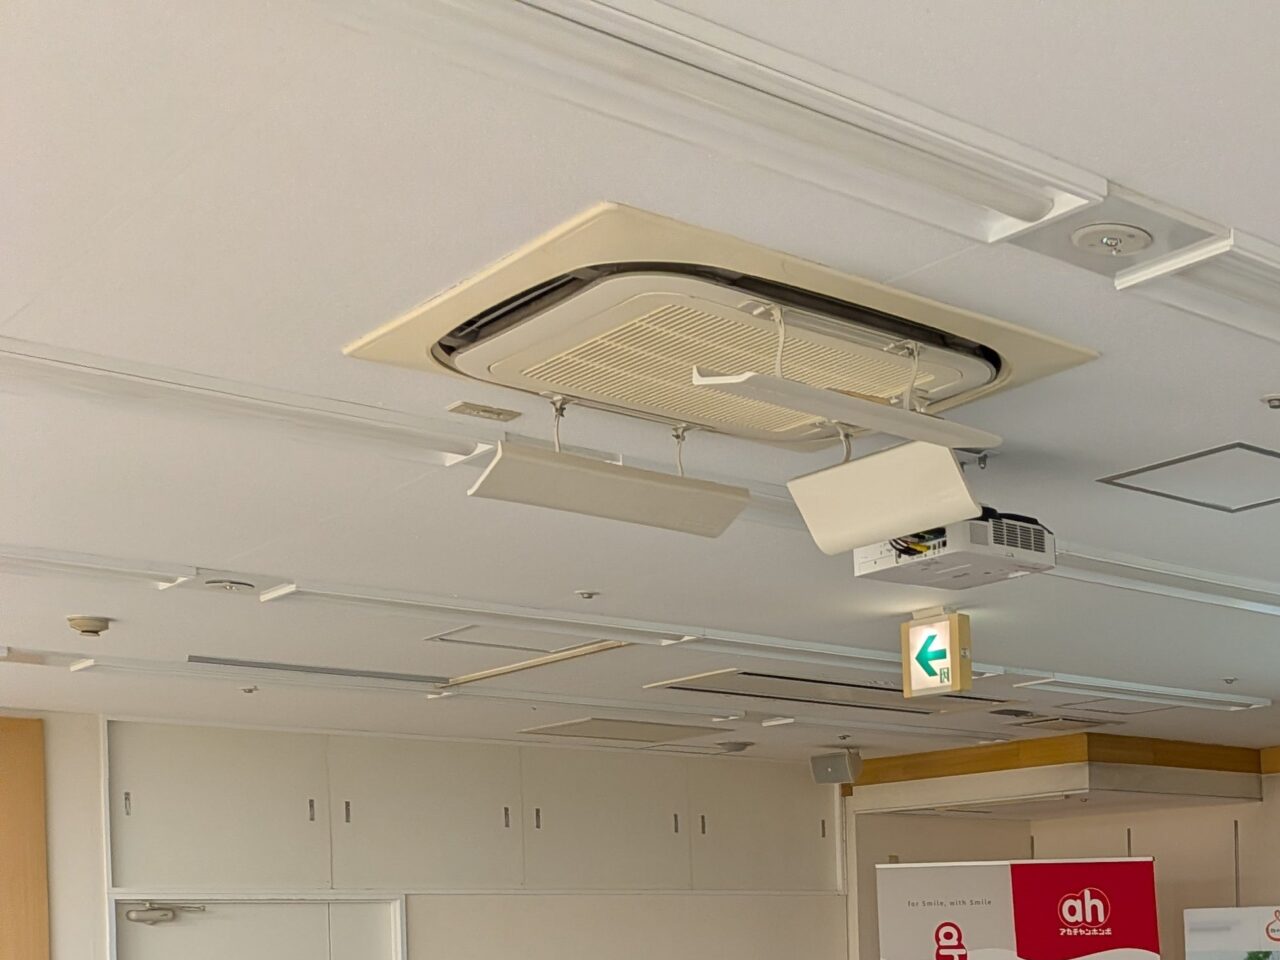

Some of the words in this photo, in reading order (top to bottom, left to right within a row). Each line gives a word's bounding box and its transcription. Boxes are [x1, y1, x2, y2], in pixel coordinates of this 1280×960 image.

[922, 899, 947, 907] Smile,
[969, 898, 992, 906] Smile
[1062, 889, 1104, 922] ah
